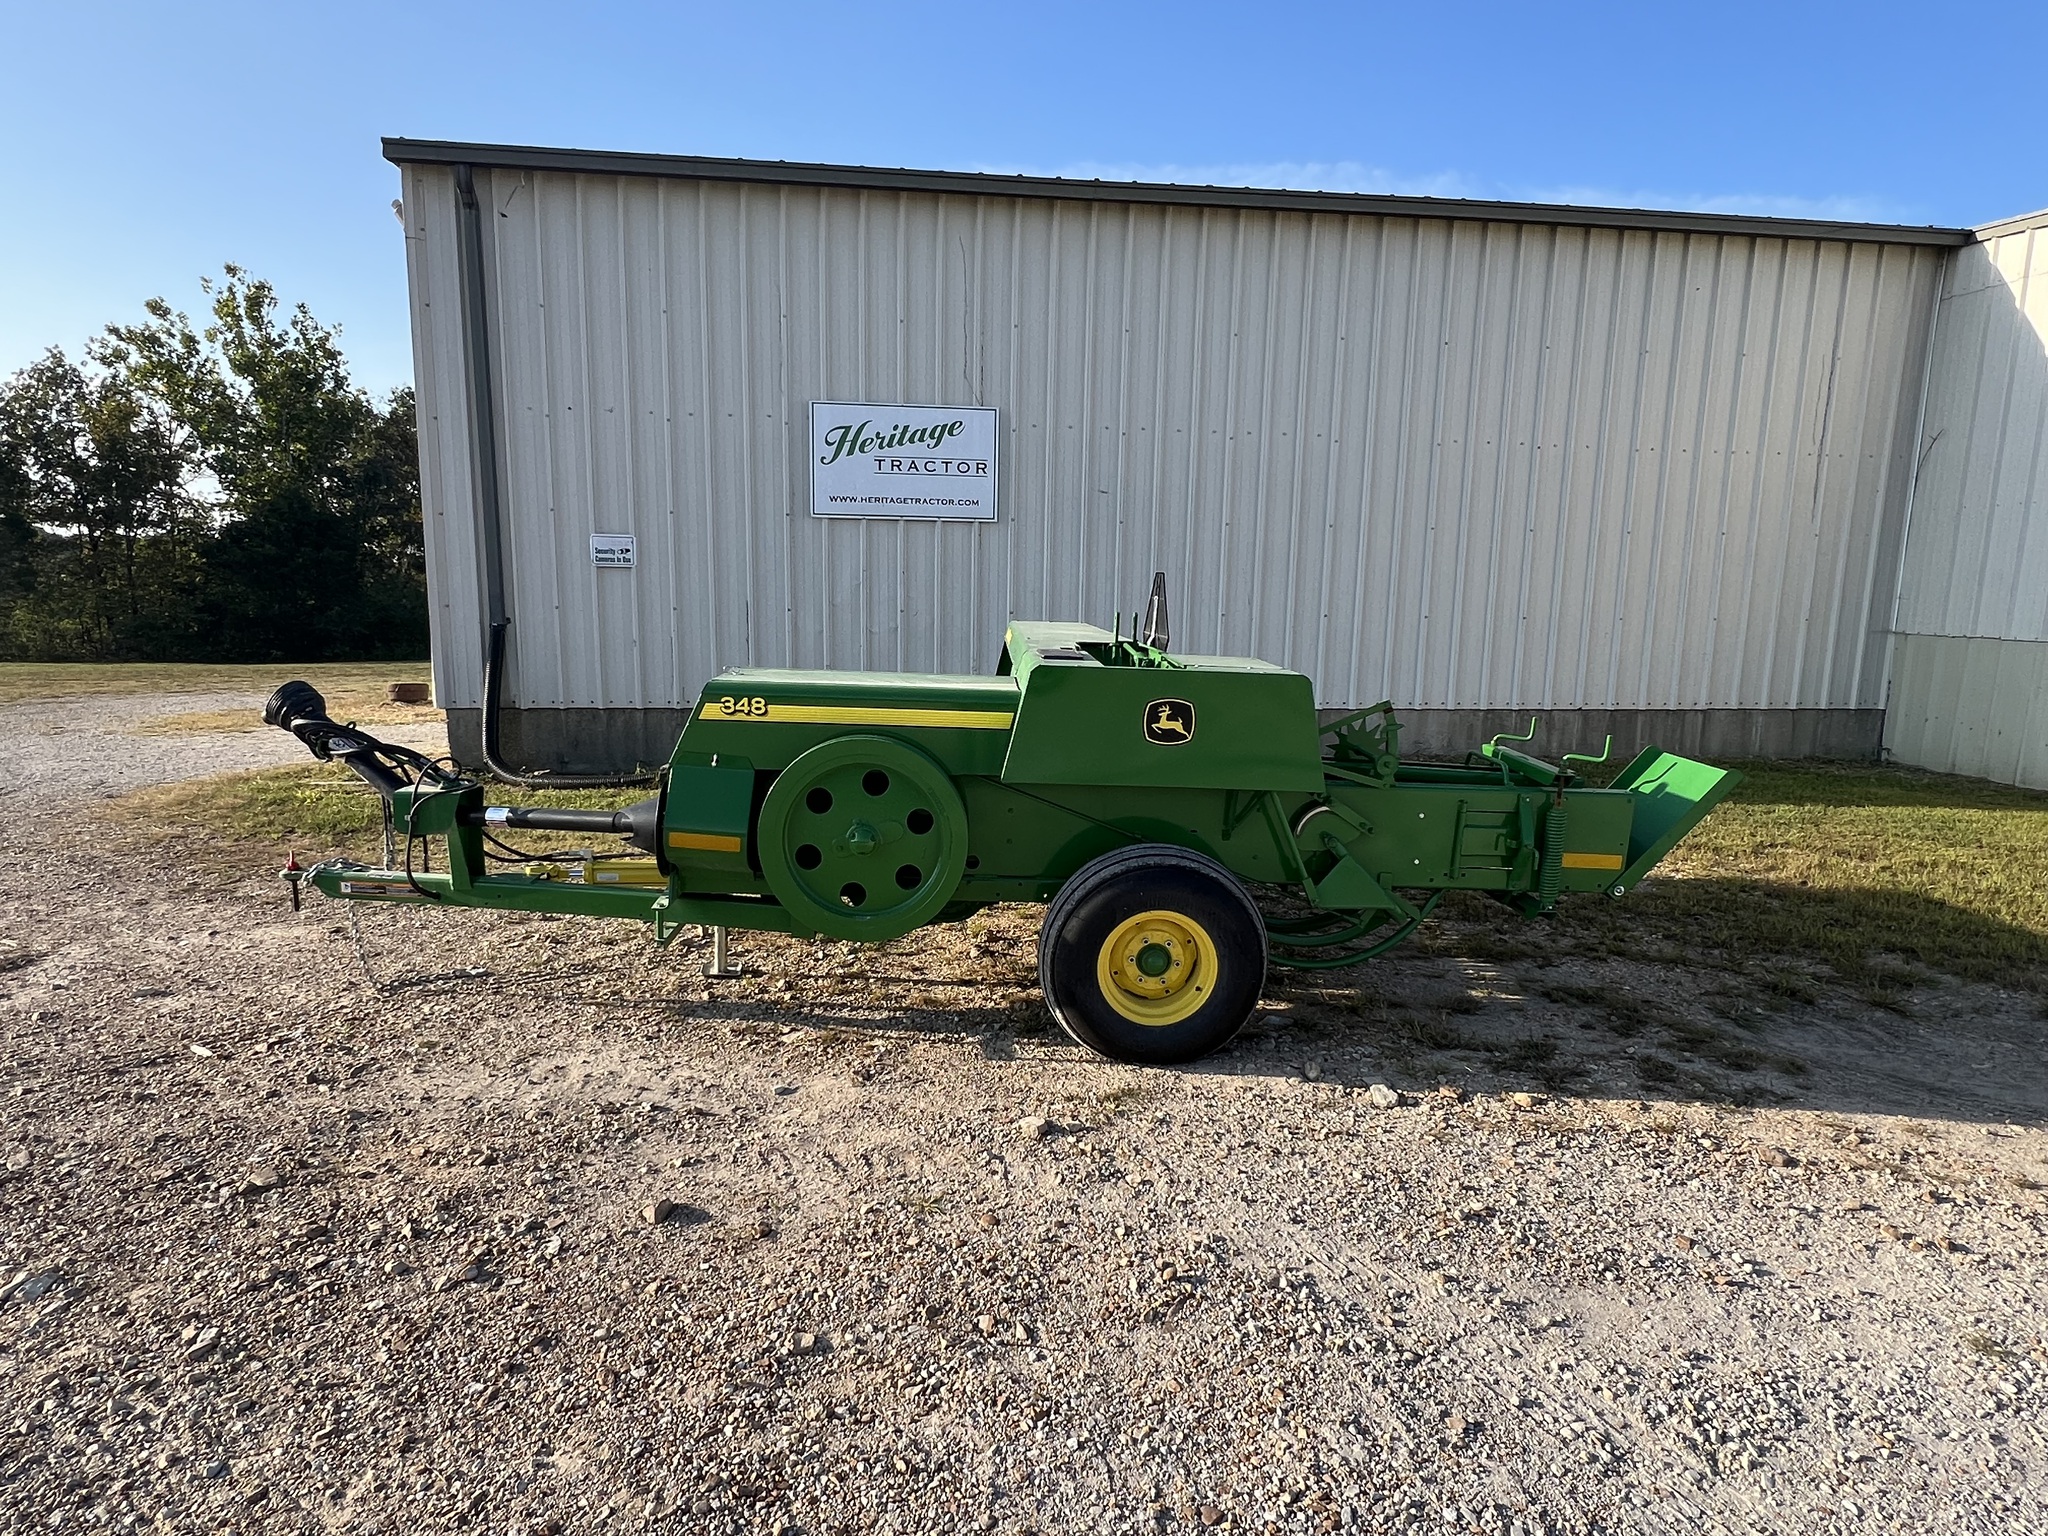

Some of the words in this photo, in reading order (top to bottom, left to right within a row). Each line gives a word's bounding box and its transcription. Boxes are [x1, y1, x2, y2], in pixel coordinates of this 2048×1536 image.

[820, 420, 966, 465] Heritage
[874, 458, 988, 475] TRACTOR
[829, 495, 980, 507] WWW.HERITAGETRACTOR.COM
[595, 547, 616, 556] Security
[720, 696, 767, 715] 348
